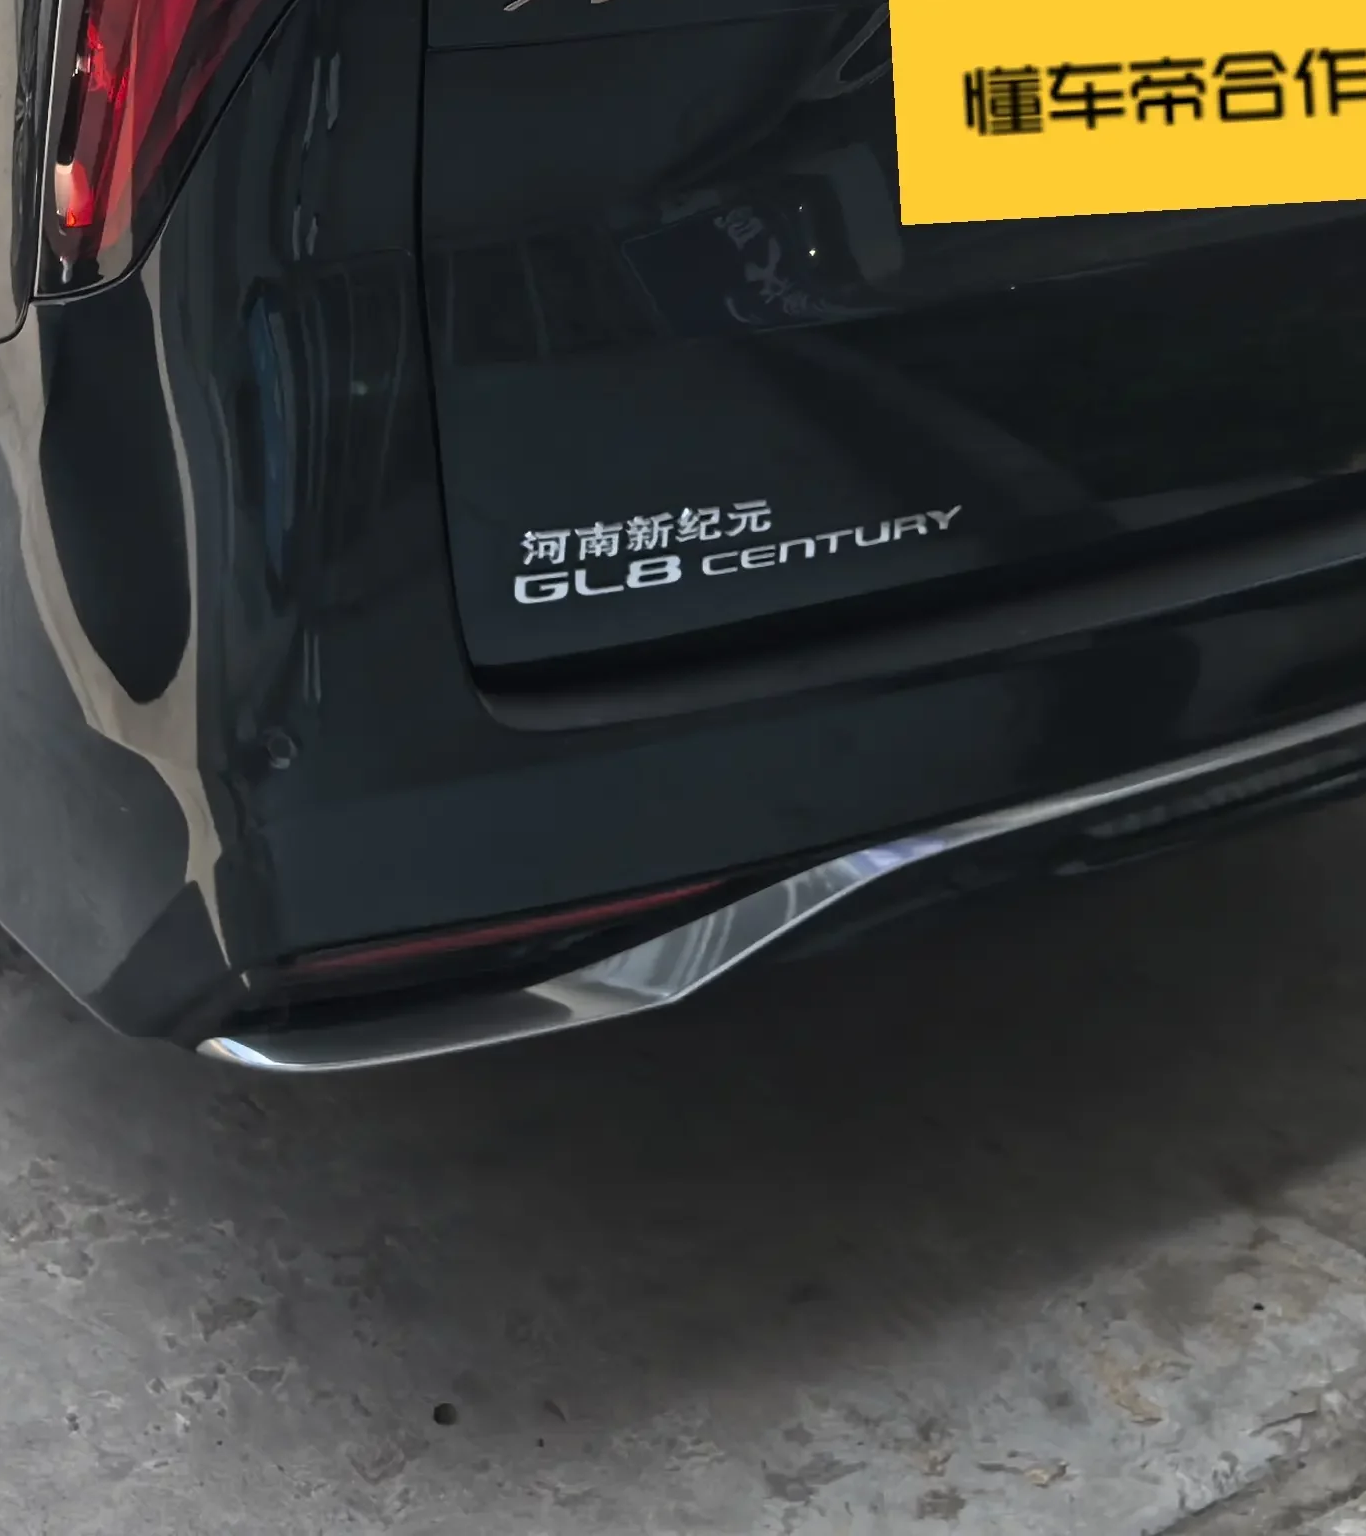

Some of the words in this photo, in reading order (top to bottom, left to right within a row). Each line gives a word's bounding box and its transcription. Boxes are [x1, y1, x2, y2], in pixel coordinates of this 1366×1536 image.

[513, 554, 682, 604] GL8
[701, 504, 963, 577] CENTURY
[520, 499, 773, 565] 河南新纪元
